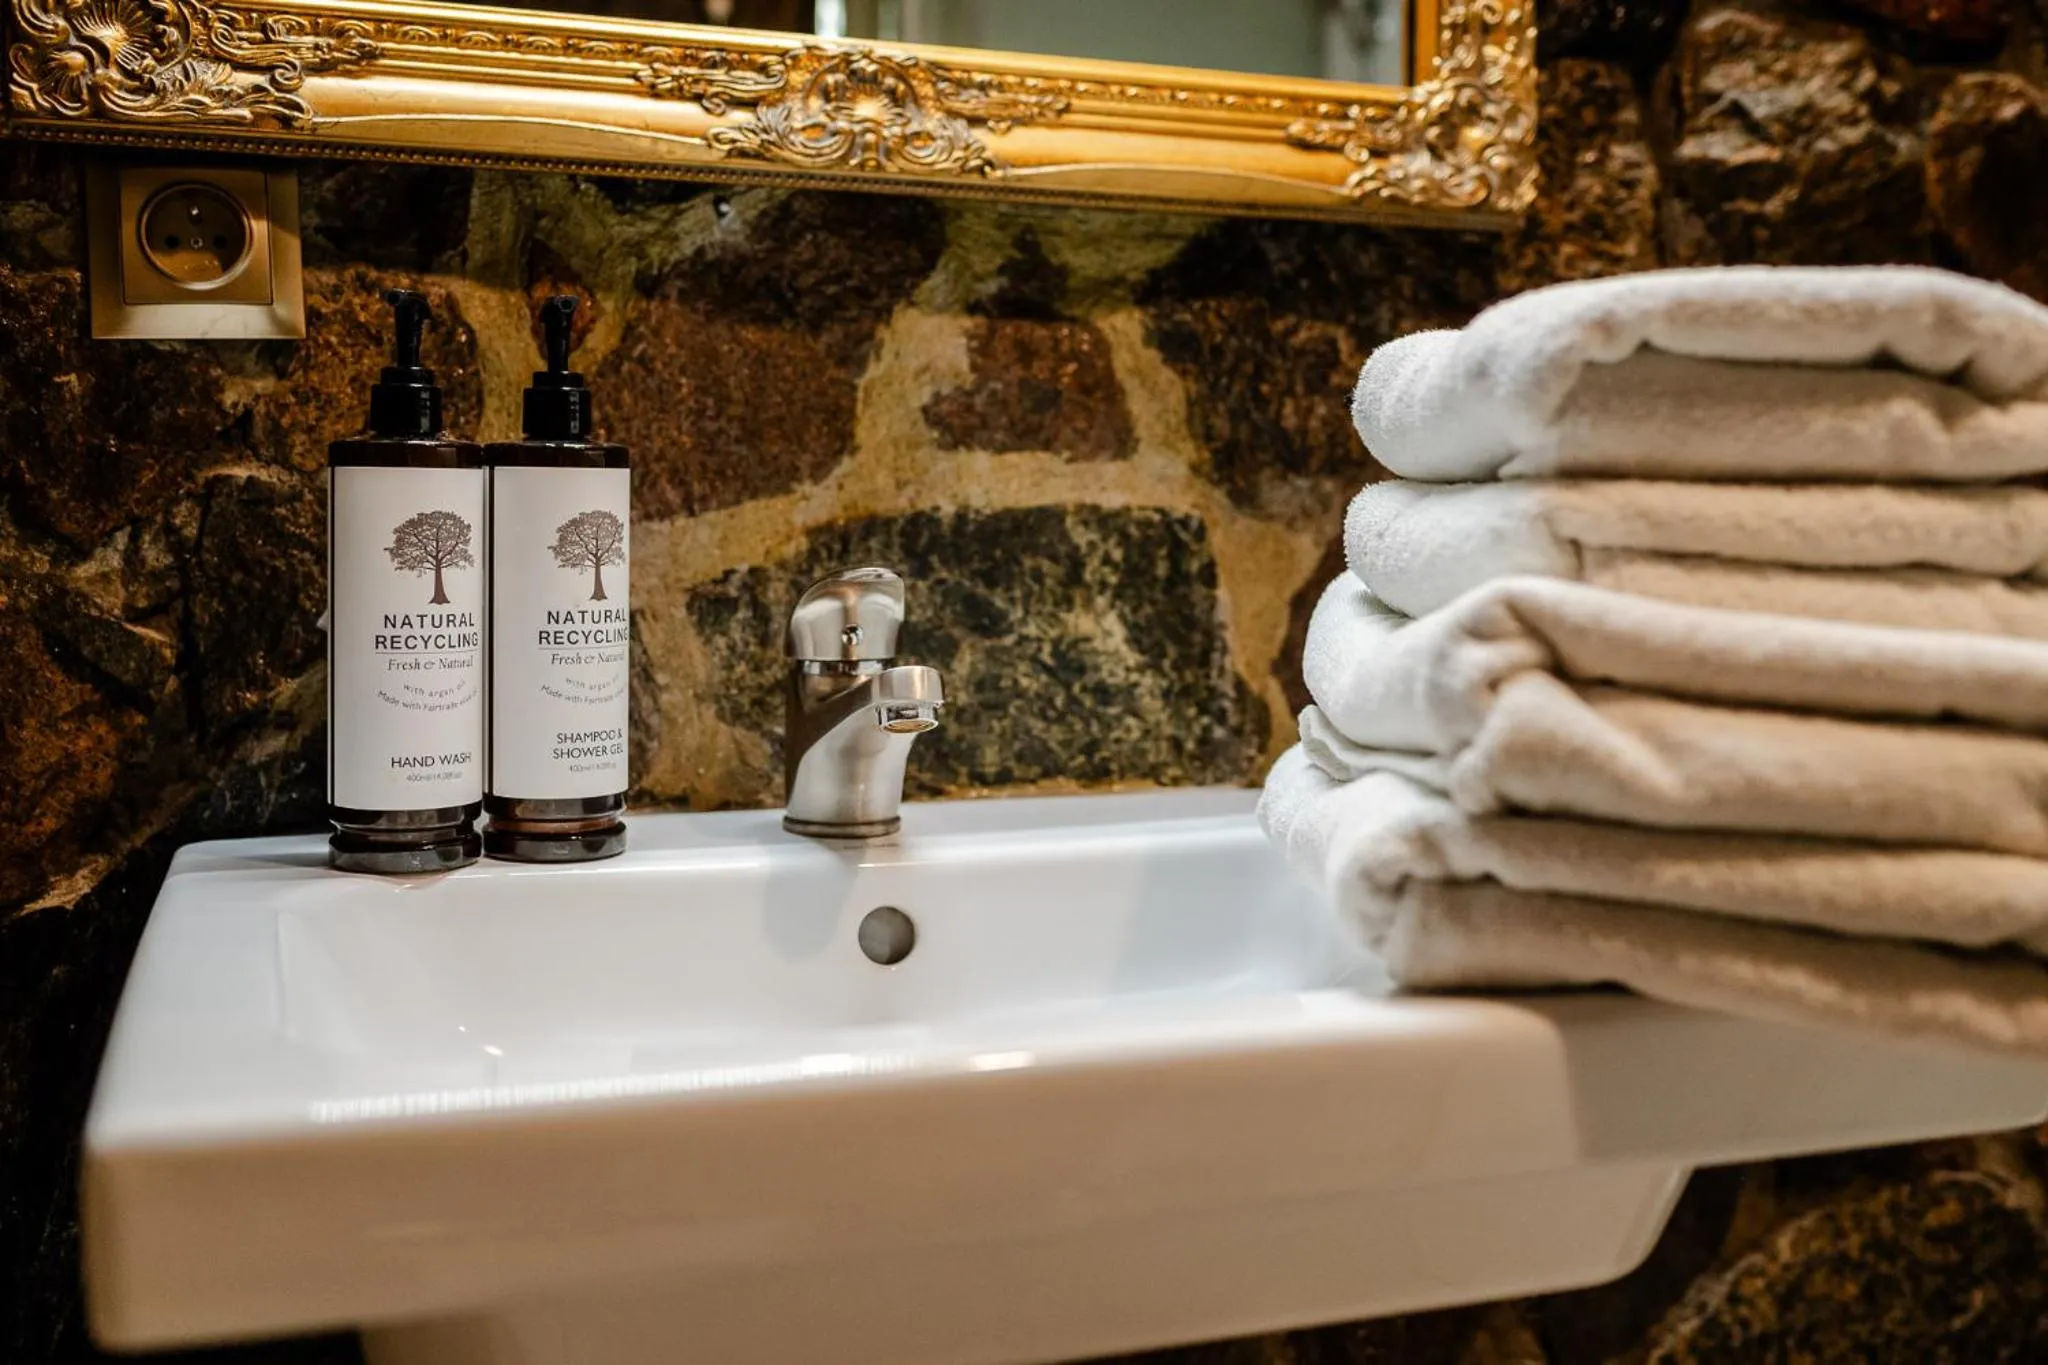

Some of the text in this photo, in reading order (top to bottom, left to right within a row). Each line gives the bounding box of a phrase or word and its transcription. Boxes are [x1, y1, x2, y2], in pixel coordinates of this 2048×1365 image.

[383, 612, 475, 629] NATURAL
[547, 608, 627, 625] NATURAL
[375, 632, 479, 650] RECYCLING
[538, 626, 628, 645] RECYCLING
[387, 657, 420, 671] Fresh
[438, 654, 474, 670] Natural
[550, 651, 582, 665] Fresh
[556, 728, 616, 745] SHAMPOO
[391, 751, 472, 768] HAND WASH
[552, 744, 609, 760] SHOWER
